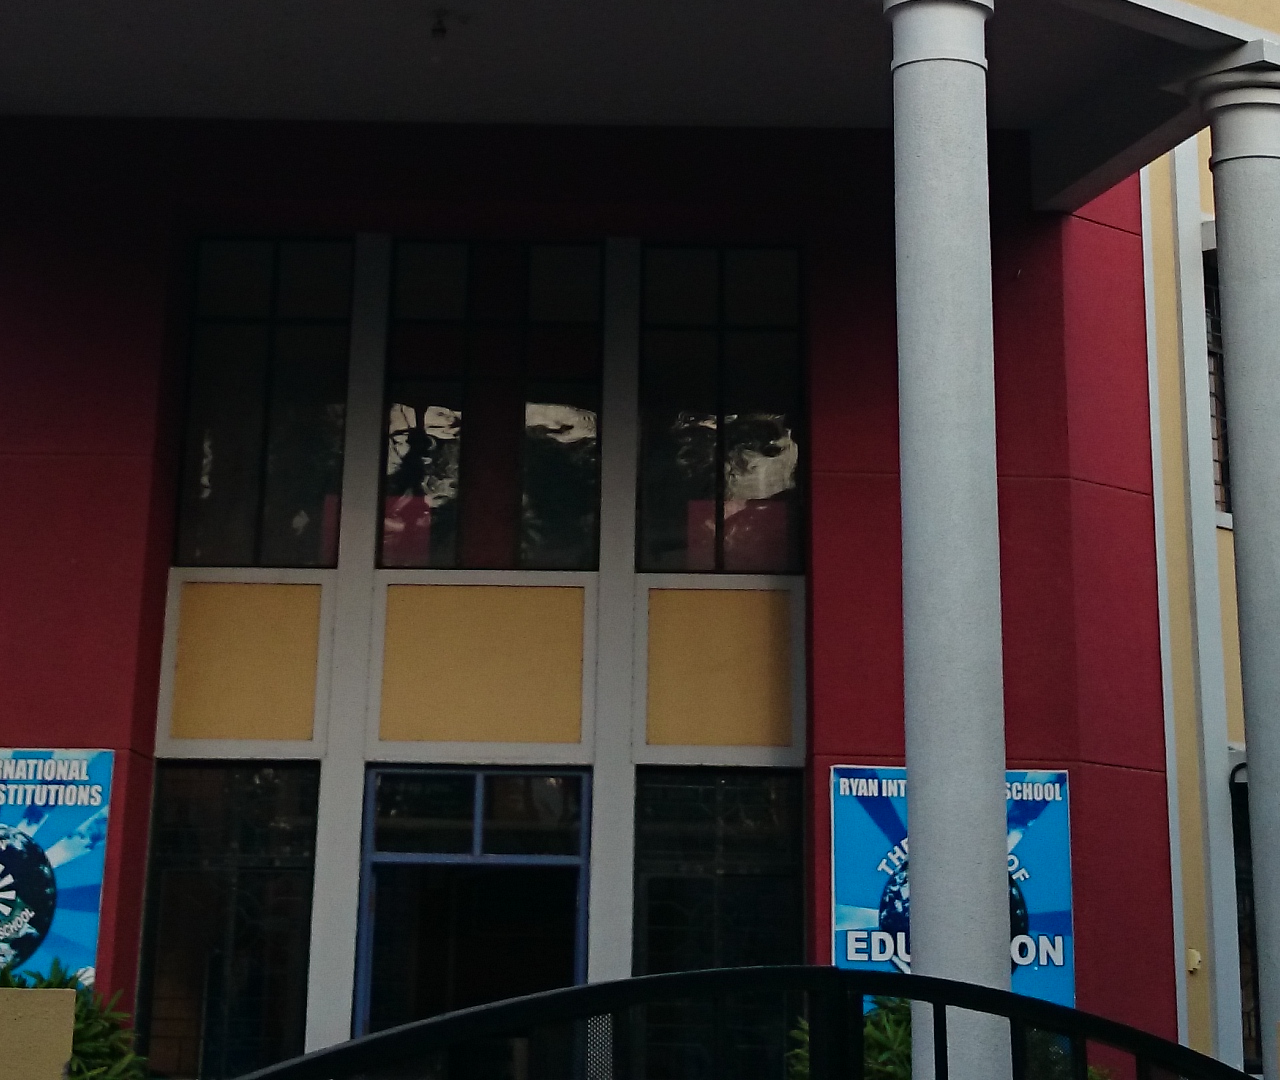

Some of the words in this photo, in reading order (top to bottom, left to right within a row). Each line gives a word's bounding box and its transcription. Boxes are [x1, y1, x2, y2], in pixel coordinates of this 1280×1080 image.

[839, 777, 879, 797] RYAN
[1007, 854, 1030, 881] OF
[847, 930, 1065, 966] EDUON
